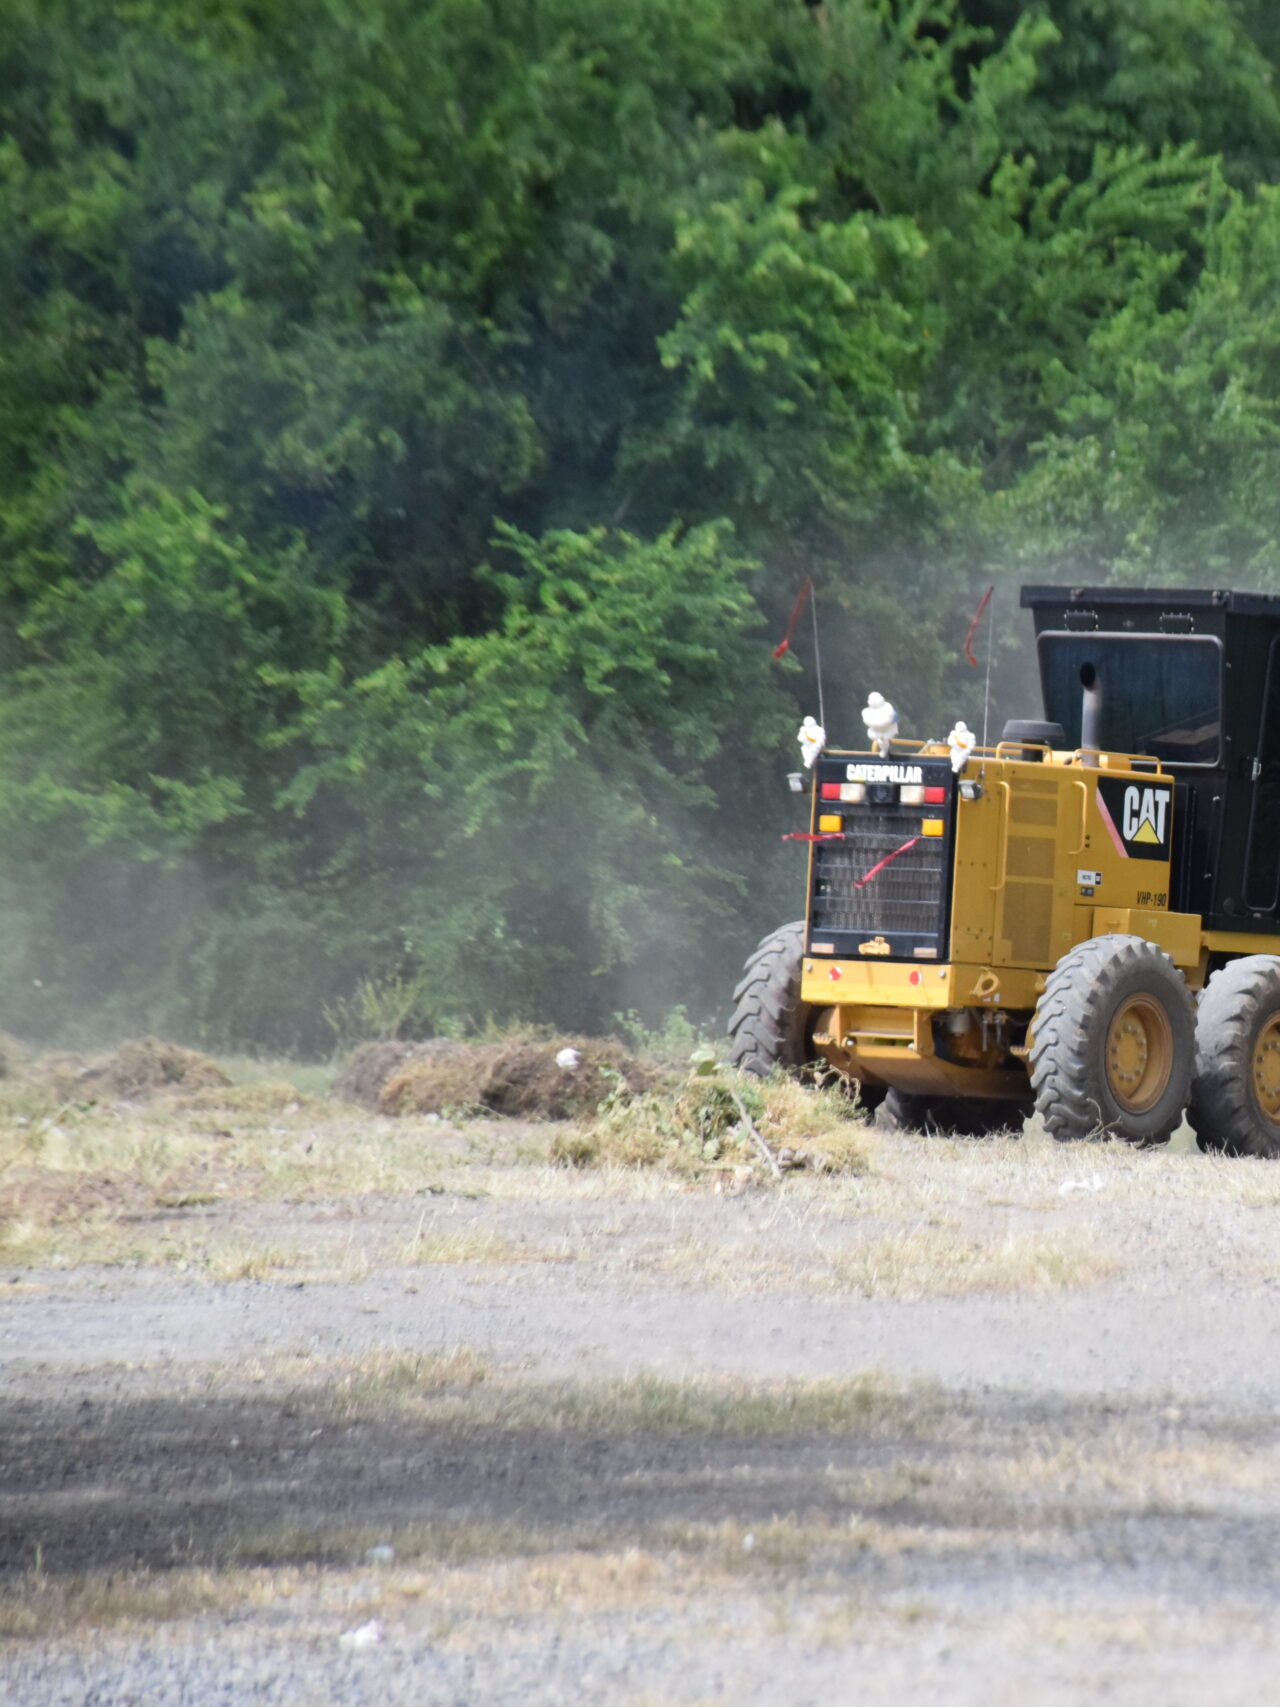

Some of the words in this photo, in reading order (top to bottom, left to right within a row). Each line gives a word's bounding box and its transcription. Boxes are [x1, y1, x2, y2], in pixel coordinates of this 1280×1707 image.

[846, 764, 923, 783] CATERPILLAR
[1122, 785, 1170, 844] CAT
[1136, 890, 1167, 907] VHP-190
